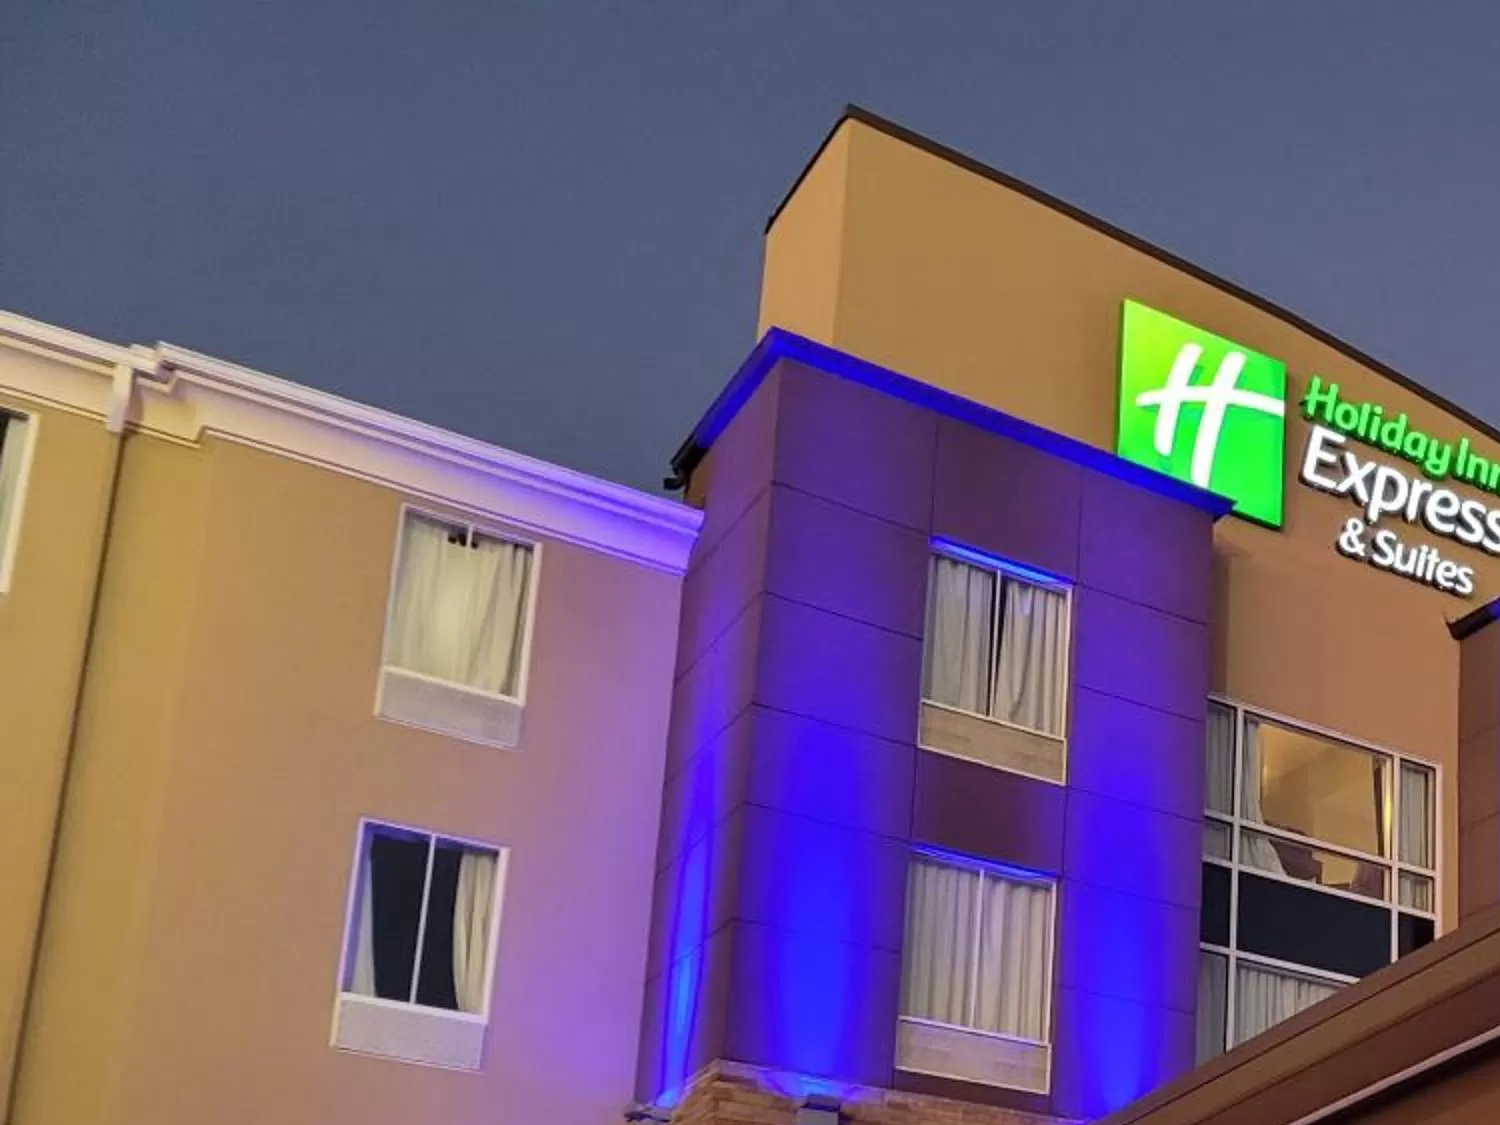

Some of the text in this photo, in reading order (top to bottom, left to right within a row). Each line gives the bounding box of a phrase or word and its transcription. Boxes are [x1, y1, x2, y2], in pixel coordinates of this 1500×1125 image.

[1303, 376, 1451, 479] Holiday
[1339, 519, 1475, 593] & Suites
